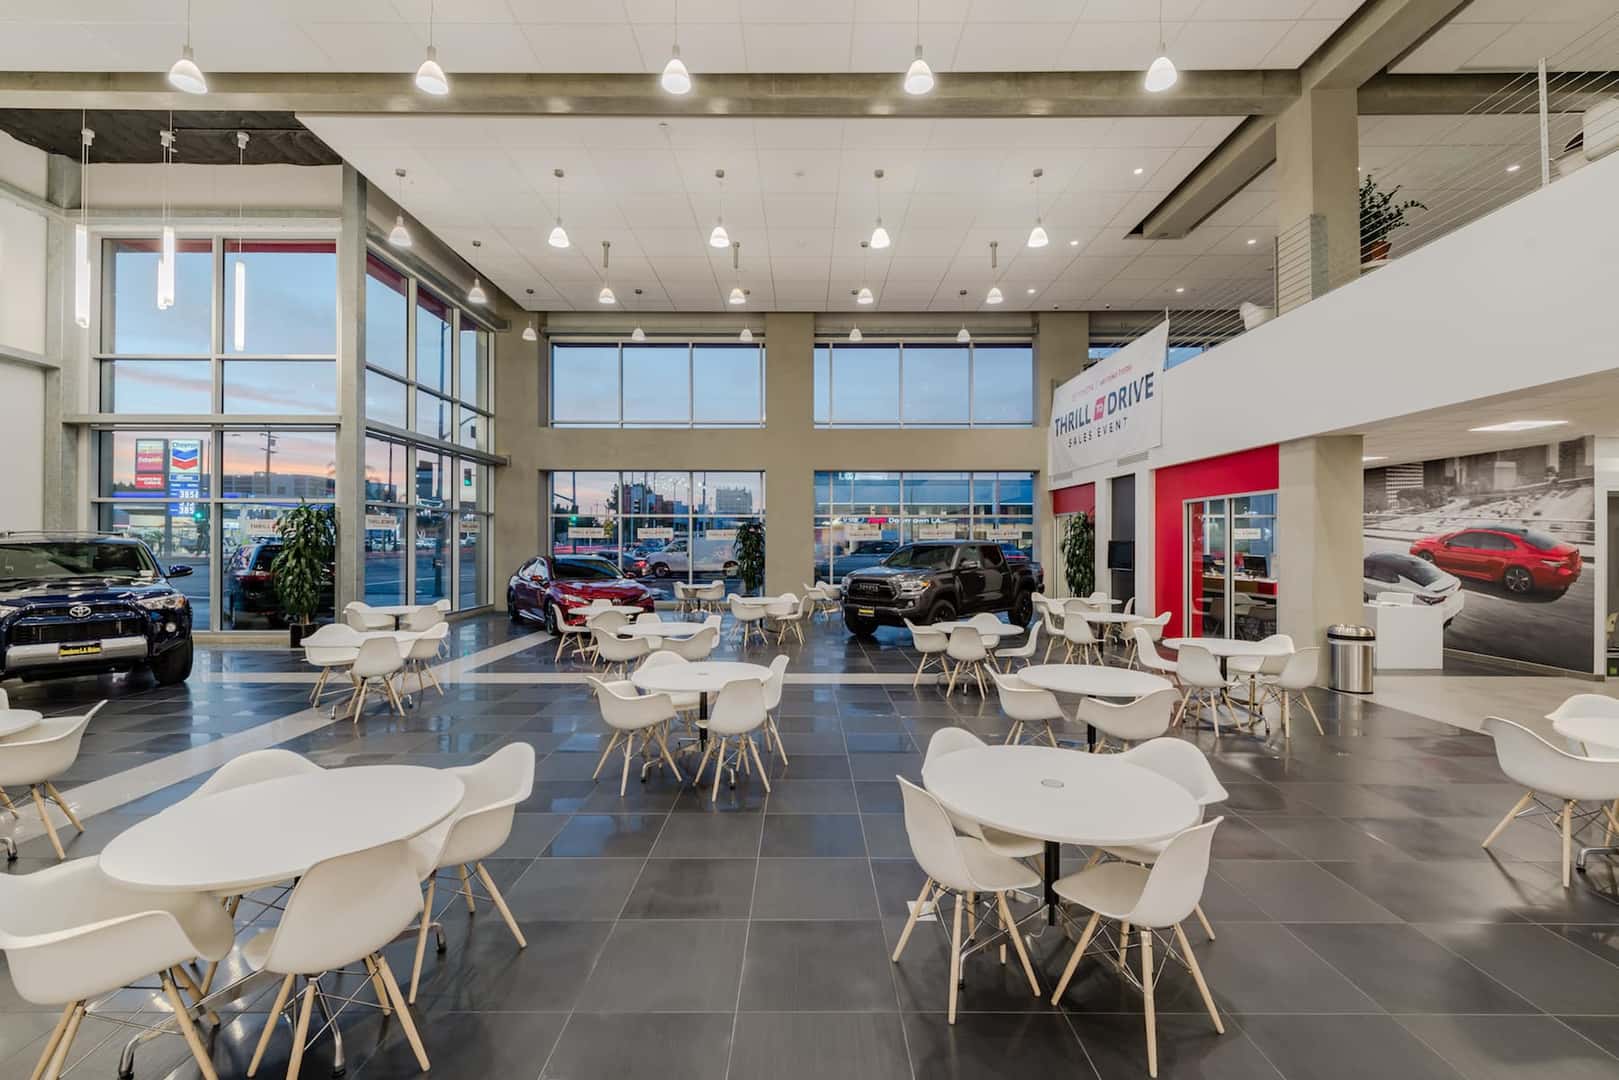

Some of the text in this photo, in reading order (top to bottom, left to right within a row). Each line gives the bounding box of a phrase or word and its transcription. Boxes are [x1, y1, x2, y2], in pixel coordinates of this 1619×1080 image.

[1055, 405, 1091, 437] THRILL
[1107, 371, 1154, 416] DRIVE
[1068, 416, 1128, 448] SALES EVENT
